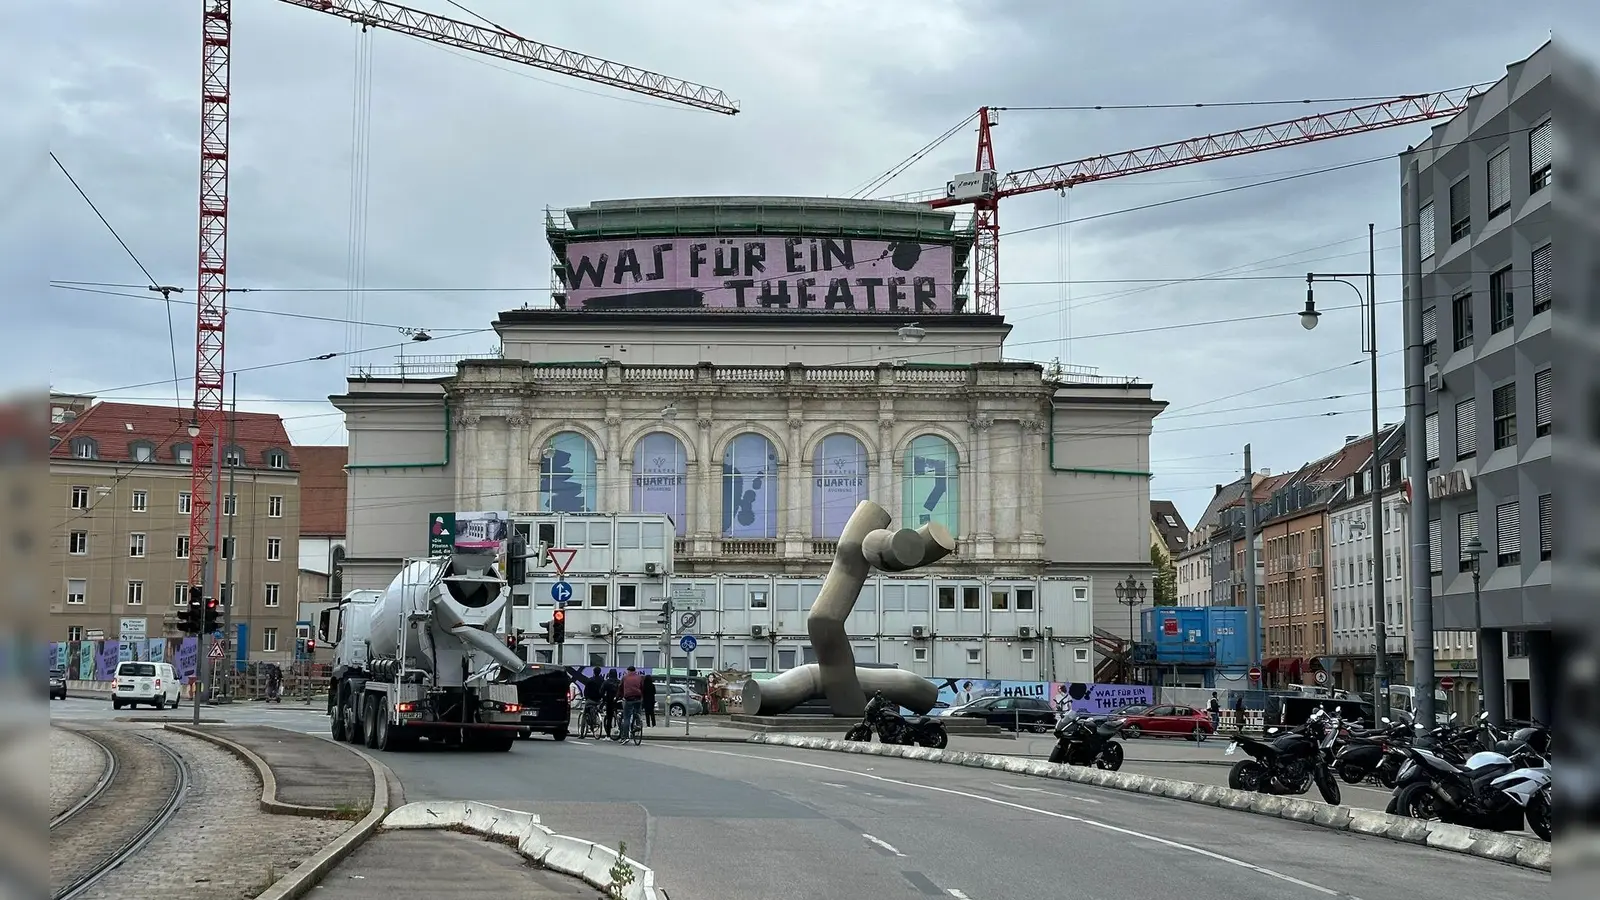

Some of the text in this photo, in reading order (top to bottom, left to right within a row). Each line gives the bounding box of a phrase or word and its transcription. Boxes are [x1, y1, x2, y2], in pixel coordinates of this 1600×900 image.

[566, 243, 673, 290] WAS
[690, 238, 766, 277] FÜR
[723, 277, 937, 312] THEATER
[683, 616, 694, 625] 30
[1003, 684, 1044, 697] HALLO
[1095, 689, 1115, 697] WAS
[1094, 696, 1147, 709] THEATER
